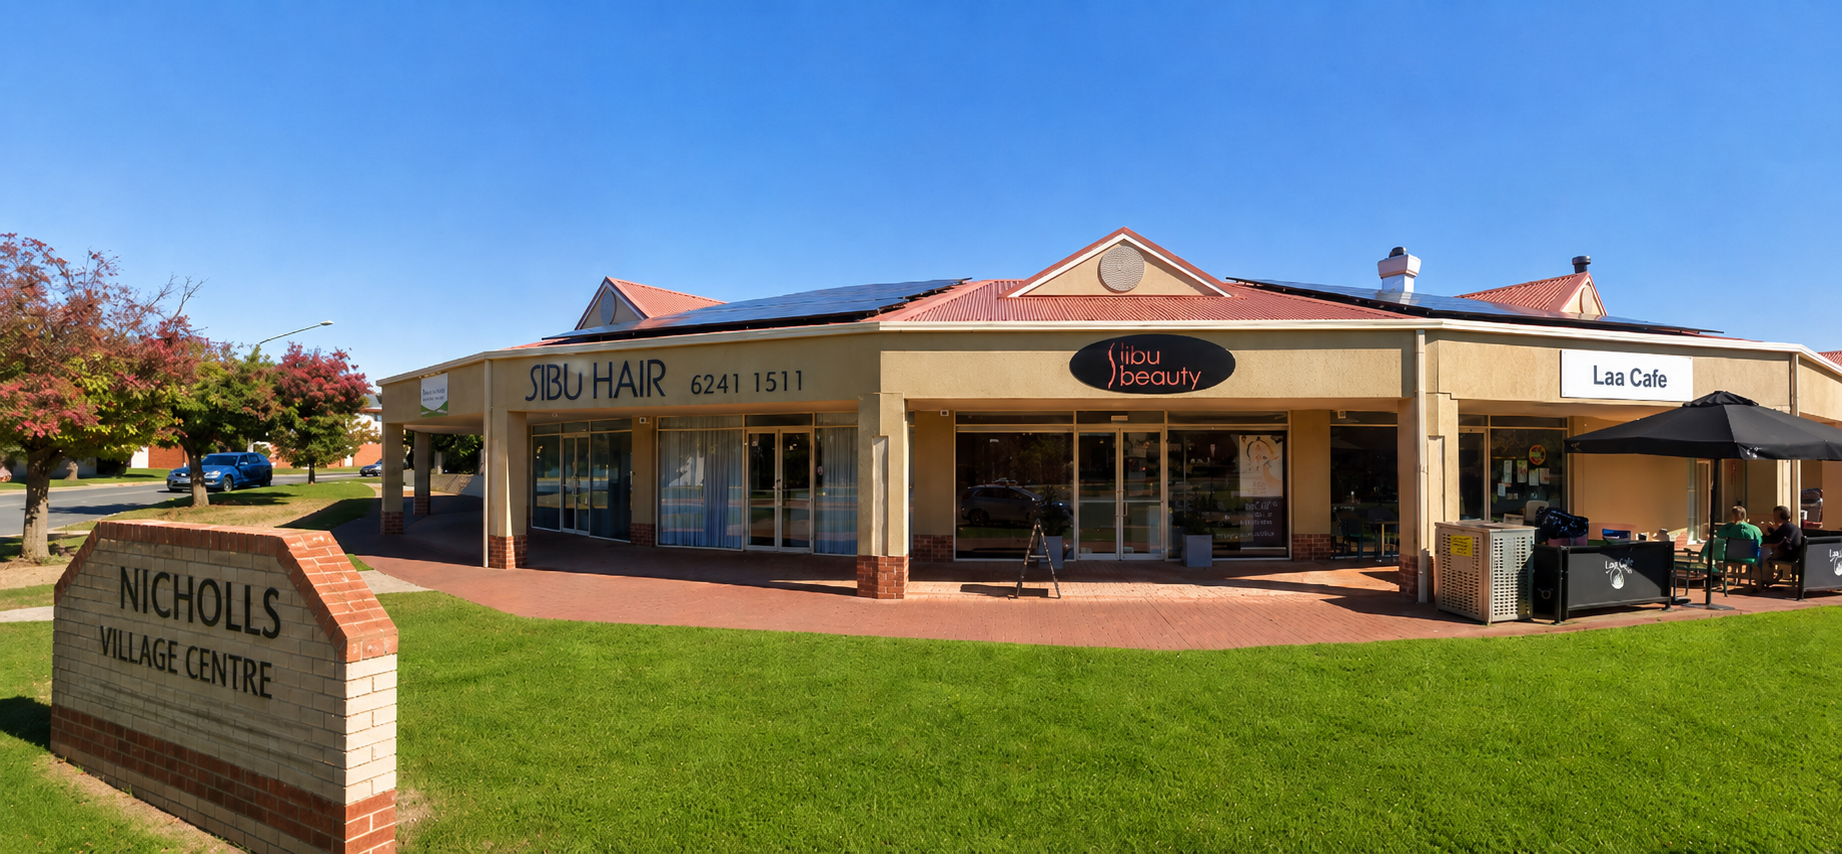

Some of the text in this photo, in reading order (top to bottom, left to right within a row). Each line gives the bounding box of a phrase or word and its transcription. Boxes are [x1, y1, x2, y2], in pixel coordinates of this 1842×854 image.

[525, 359, 802, 401] SIBU HAIR 6241 1511
[1119, 365, 1202, 390] beauty
[1593, 365, 1668, 389] Laa Cafe
[120, 566, 281, 639] NICHOLLS
[100, 625, 273, 699] VILLAGE CENTRE
